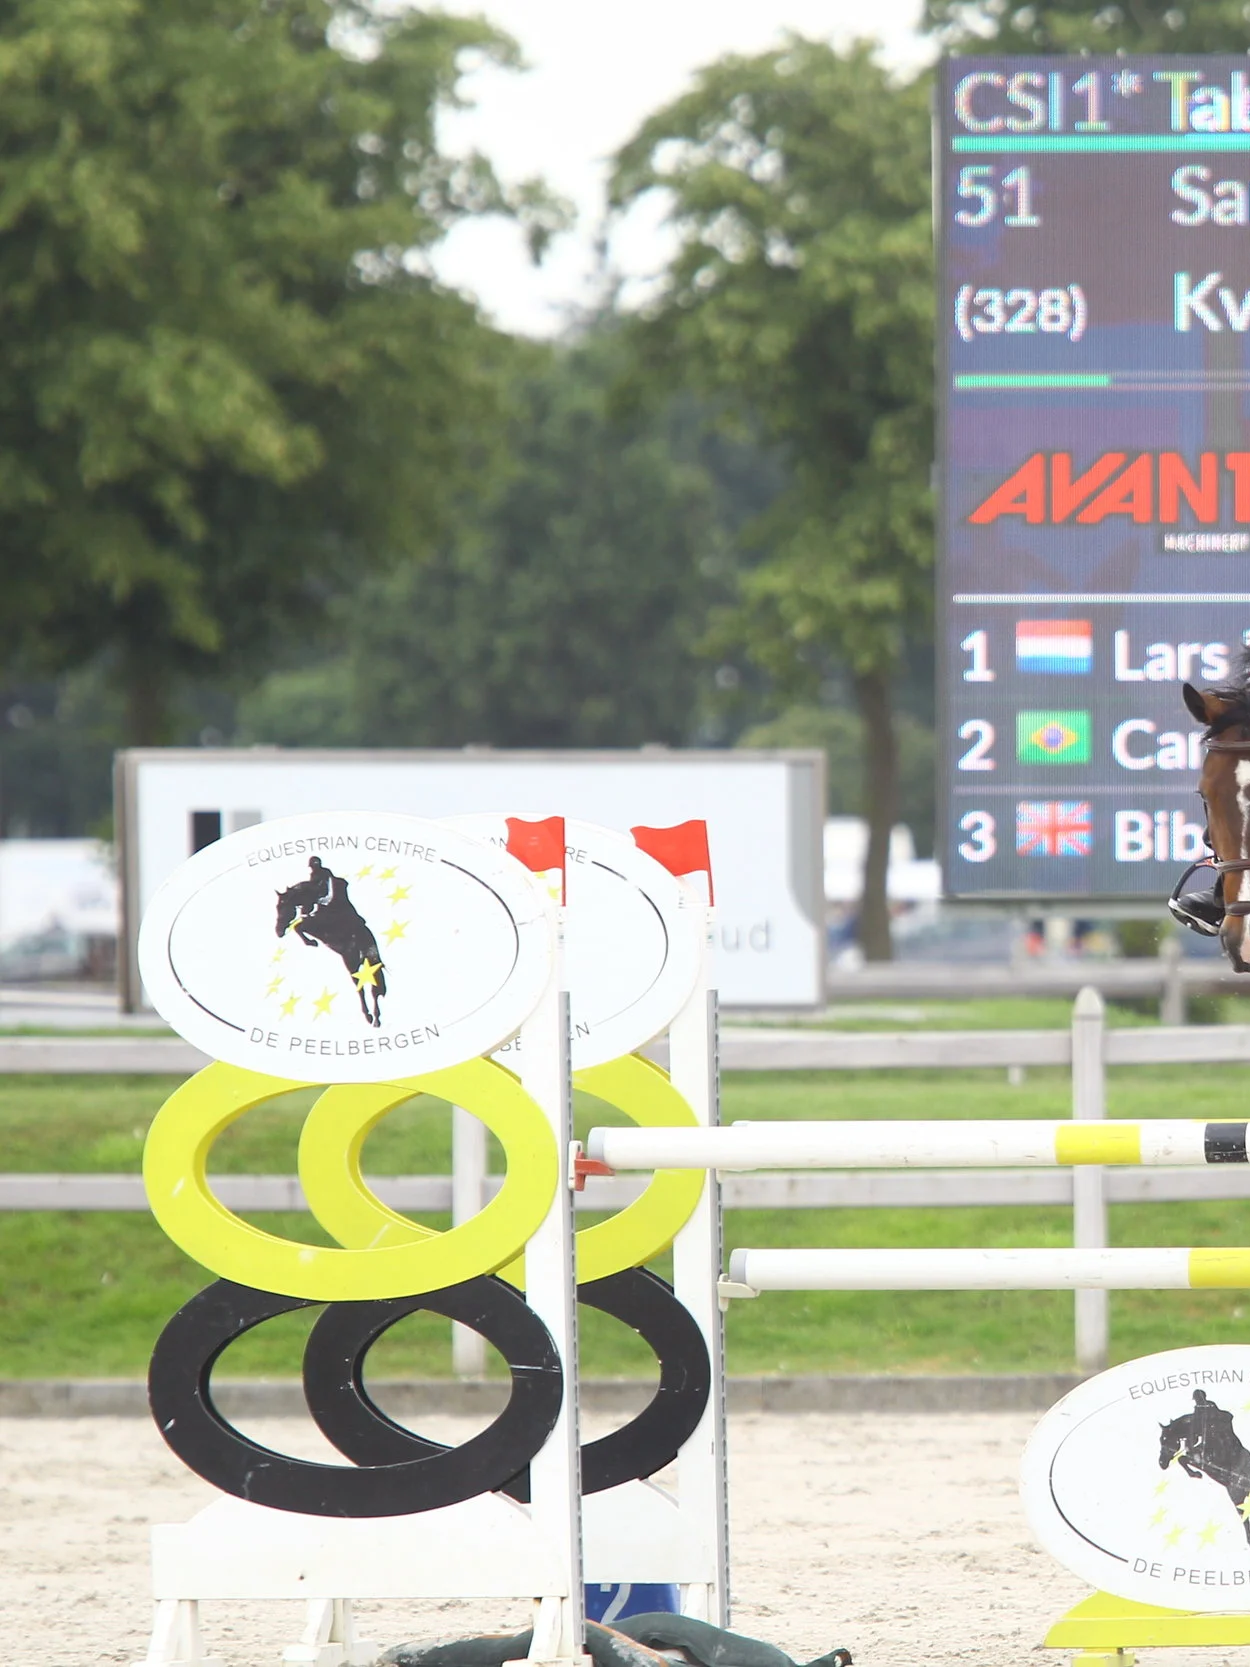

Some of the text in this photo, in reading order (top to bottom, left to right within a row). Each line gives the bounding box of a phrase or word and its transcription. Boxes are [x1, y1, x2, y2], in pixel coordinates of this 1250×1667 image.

[955, 166, 1041, 226] 51
[954, 284, 1088, 341] (328)
[960, 630, 995, 682] 1
[1114, 630, 1229, 682] Lars
[957, 720, 996, 771] 2
[246, 835, 437, 868] EQUESTRIAN CENTRE
[957, 810, 996, 862] 3
[1114, 809, 1215, 862] Bib
[250, 1023, 440, 1056] DE PEELBERGEN
[1129, 1369, 1244, 1399] EQUESTRIAN
[1134, 1557, 1161, 1578] DE
